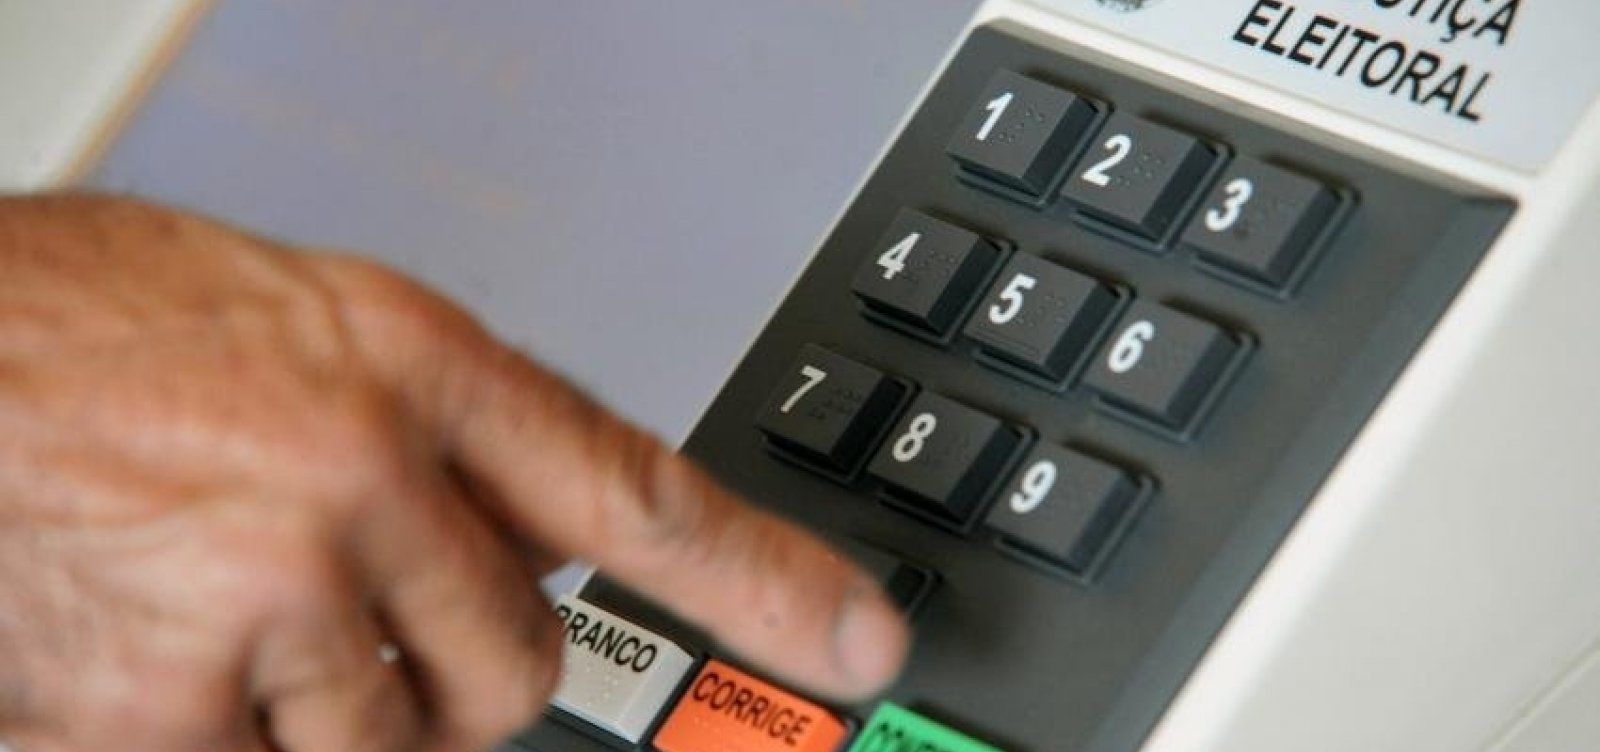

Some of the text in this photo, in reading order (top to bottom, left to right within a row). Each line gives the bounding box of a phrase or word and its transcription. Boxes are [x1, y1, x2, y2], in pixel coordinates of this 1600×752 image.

[1232, 0, 1493, 123] ELEITORAL
[976, 92, 1013, 142] 1
[1080, 134, 1132, 187] 2
[1204, 178, 1253, 232] 3
[876, 232, 922, 280] 4
[988, 273, 1036, 325] 5
[1108, 320, 1155, 374] 6
[780, 365, 827, 414] 7
[892, 413, 937, 463] 8
[1009, 460, 1058, 514] 9
[692, 672, 813, 747] CORRIGE
